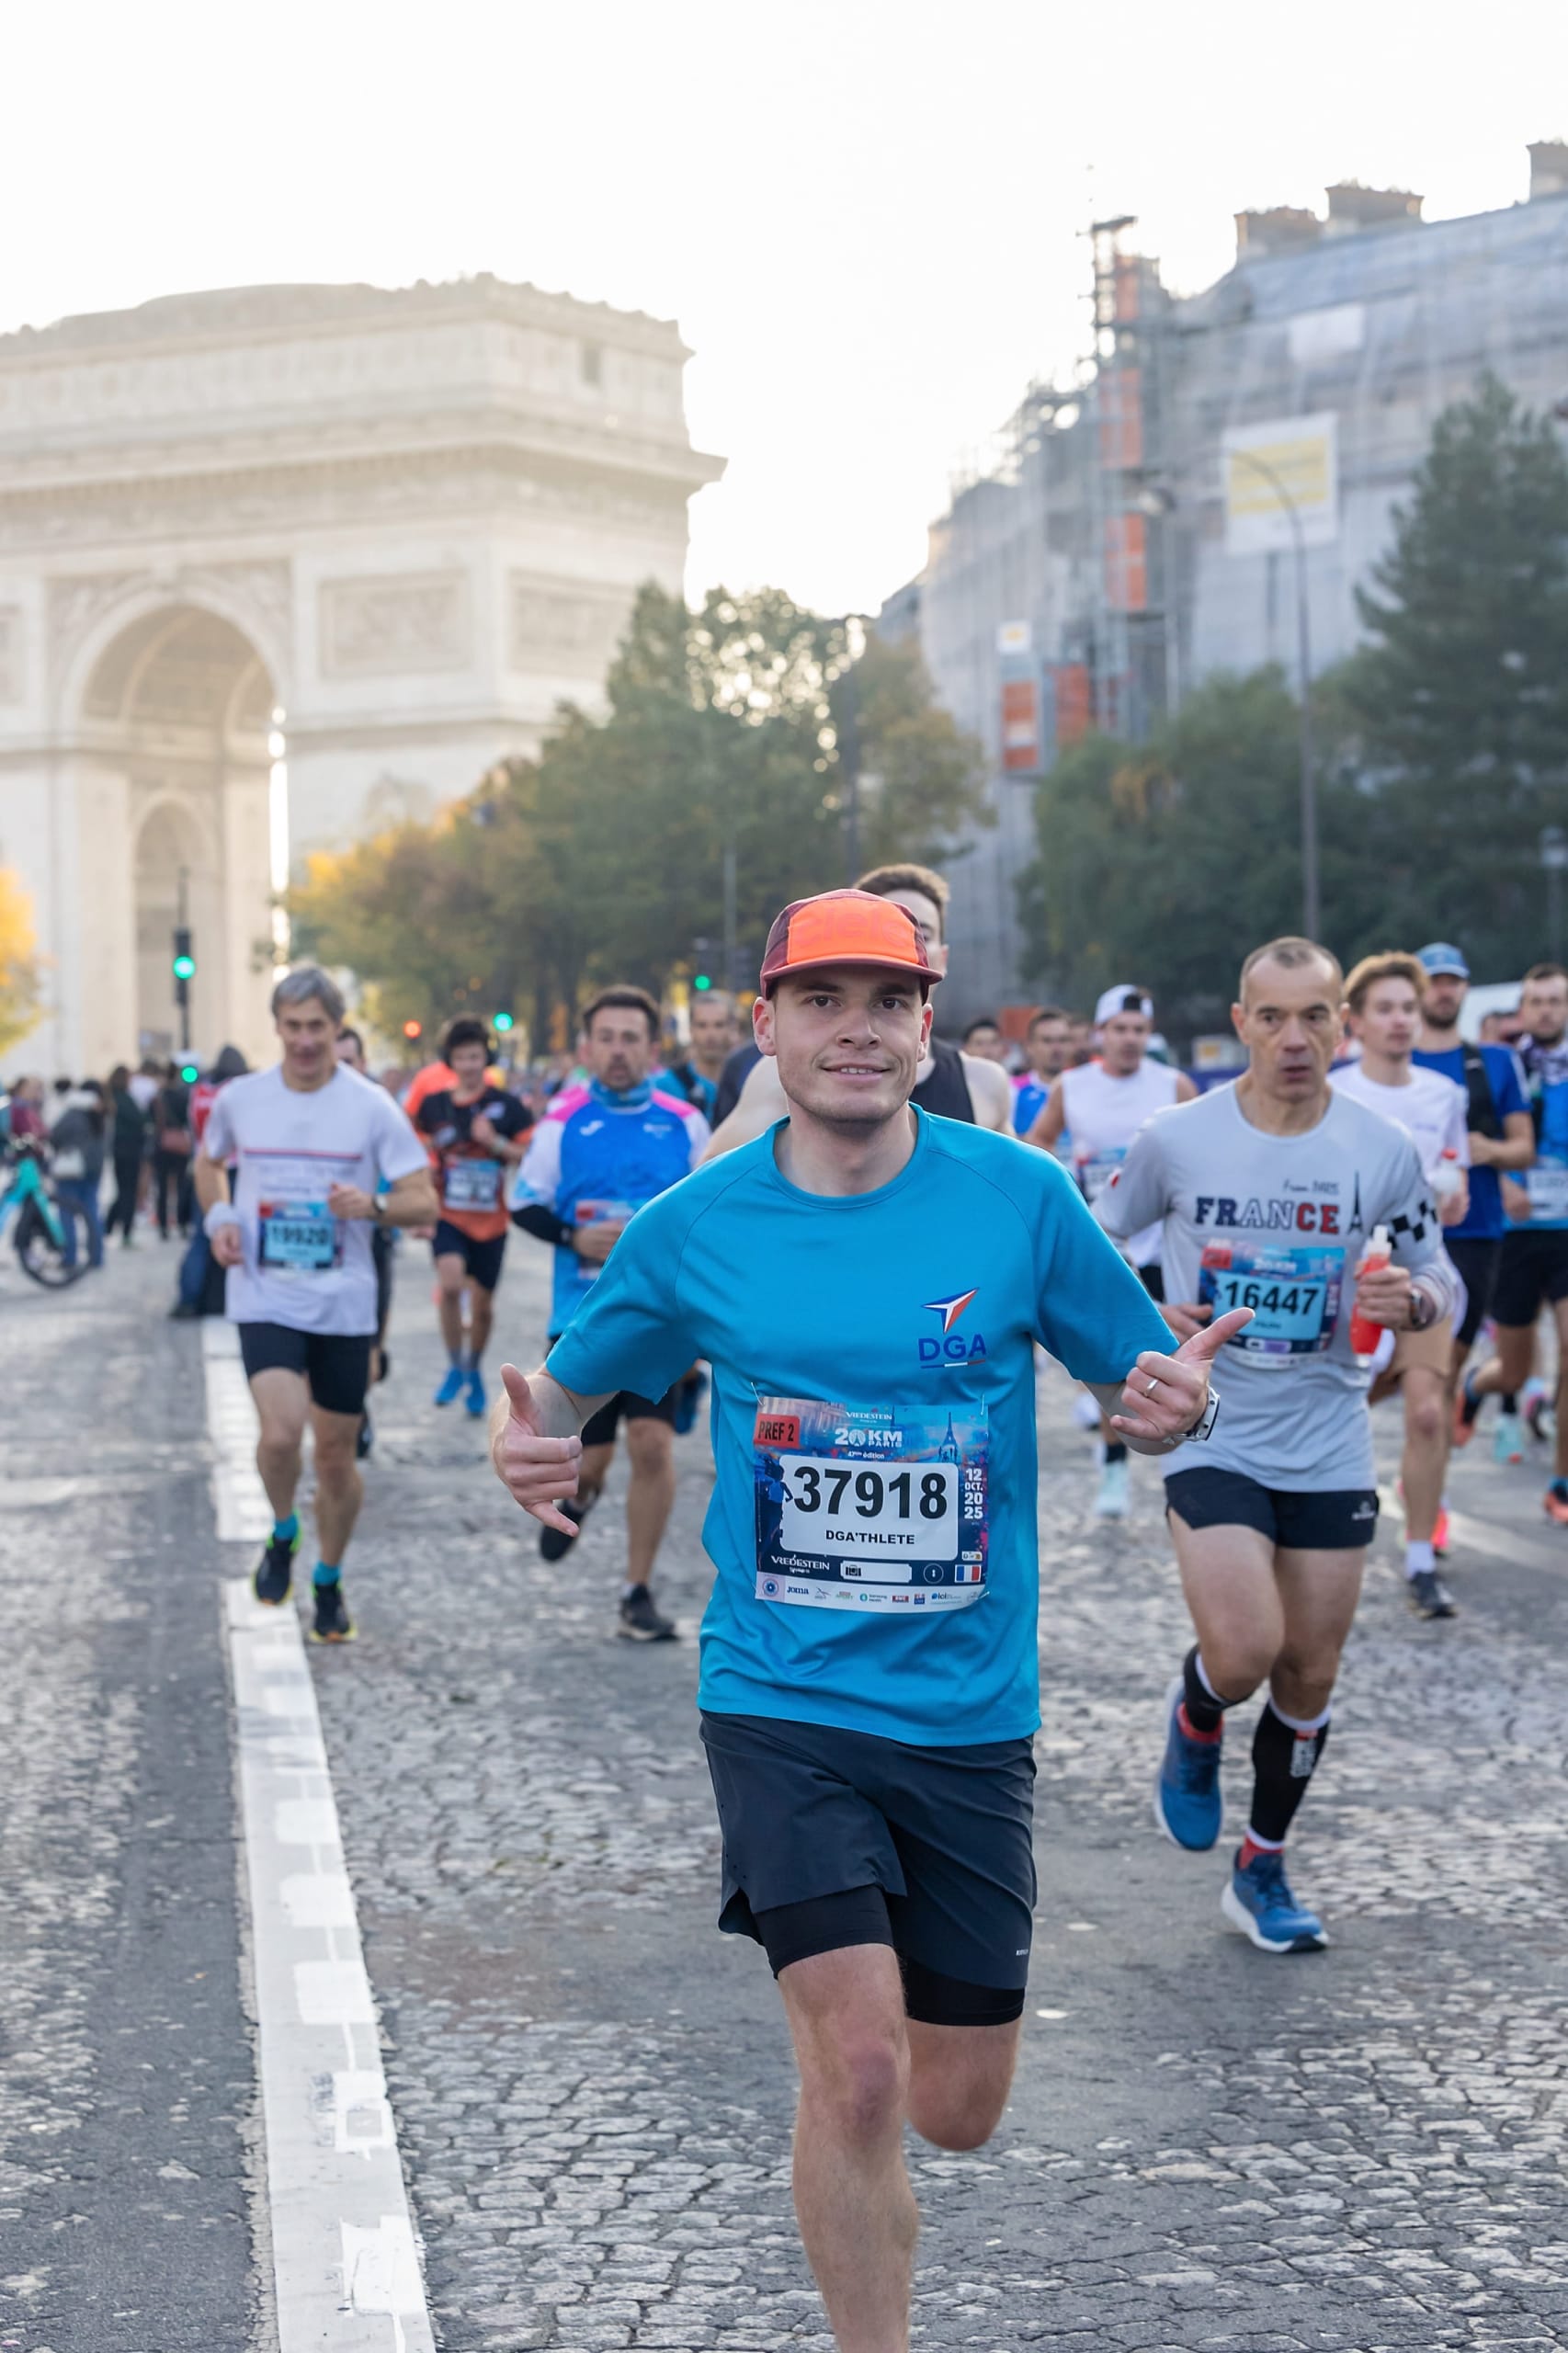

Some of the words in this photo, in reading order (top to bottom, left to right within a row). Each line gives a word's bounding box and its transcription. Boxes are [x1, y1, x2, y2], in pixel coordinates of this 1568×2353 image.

[1195, 1196, 1339, 1234] FRANCE
[1225, 1280, 1319, 1315] 16447
[918, 1334, 986, 1361] DGA
[757, 1420, 785, 1441] PREF
[788, 1424, 795, 1442] 2
[965, 1468, 982, 1481] 12
[793, 1466, 948, 1519] 37918
[964, 1482, 983, 1491] OCT.
[964, 1492, 983, 1505] 20
[964, 1506, 983, 1519] 25
[825, 1529, 915, 1545] DGA'THLETE
[770, 1554, 830, 1571] VREDESTEIN
